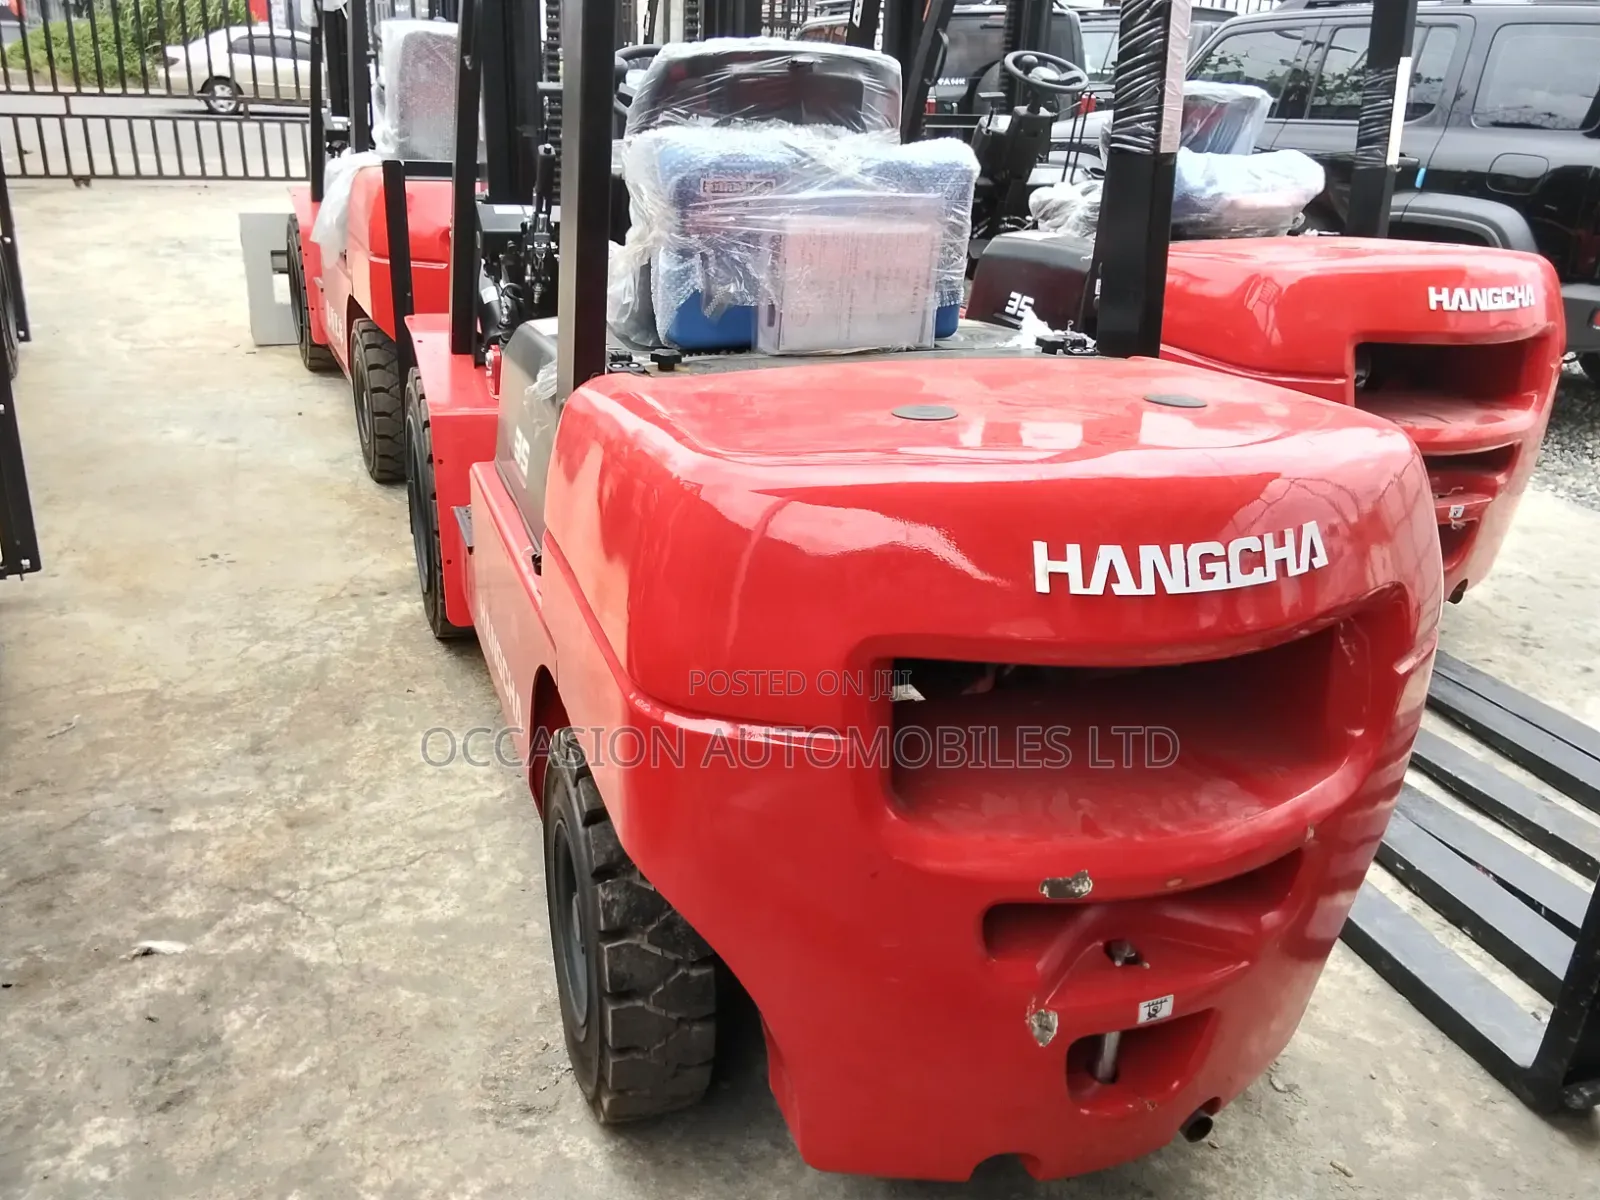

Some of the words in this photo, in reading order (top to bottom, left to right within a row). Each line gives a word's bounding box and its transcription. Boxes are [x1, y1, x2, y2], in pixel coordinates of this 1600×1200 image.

[1004, 291, 1035, 318] 35
[1427, 284, 1535, 312] HANGCHA
[514, 424, 530, 478] 35
[1032, 520, 1329, 596] HANGCHA
